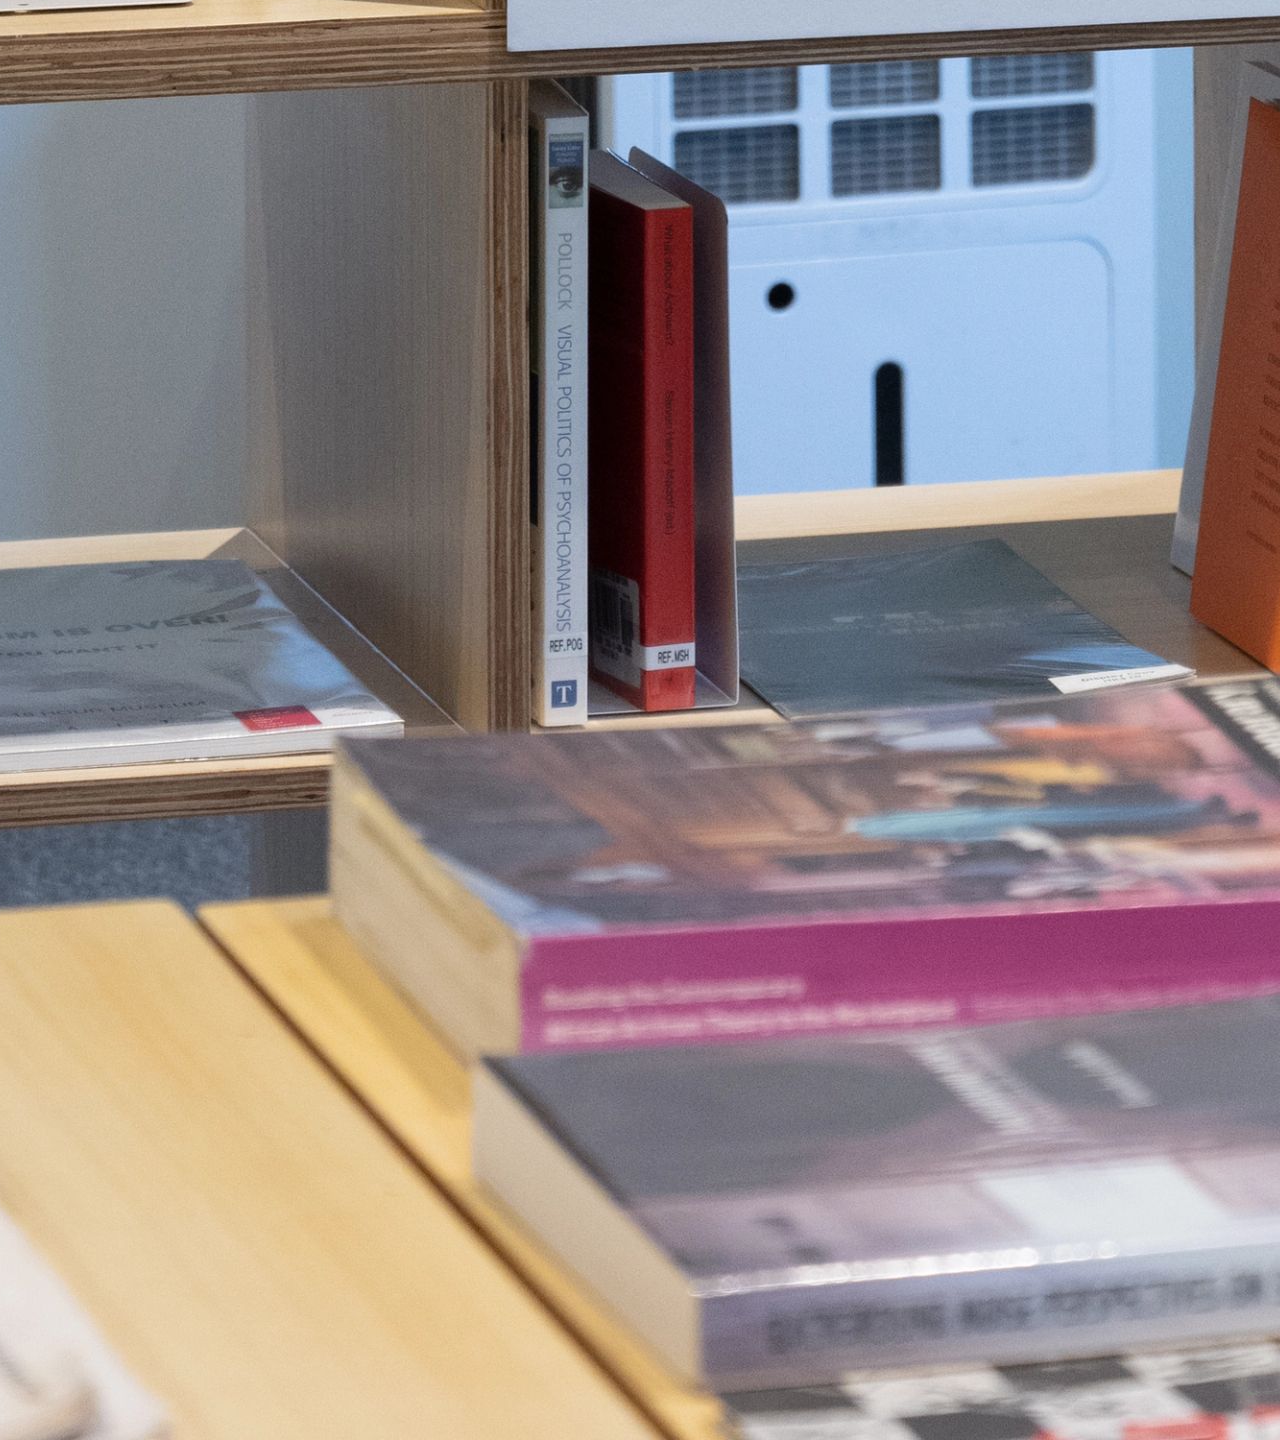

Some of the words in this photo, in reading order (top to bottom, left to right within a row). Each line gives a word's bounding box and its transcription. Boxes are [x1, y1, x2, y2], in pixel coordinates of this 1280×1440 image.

[558, 233, 572, 309] POLLOCK
[557, 324, 572, 380] VISUAL
[556, 386, 572, 457] POLITICS
[556, 463, 571, 485] OF
[556, 491, 571, 632] PSYCHOANALYSIS
